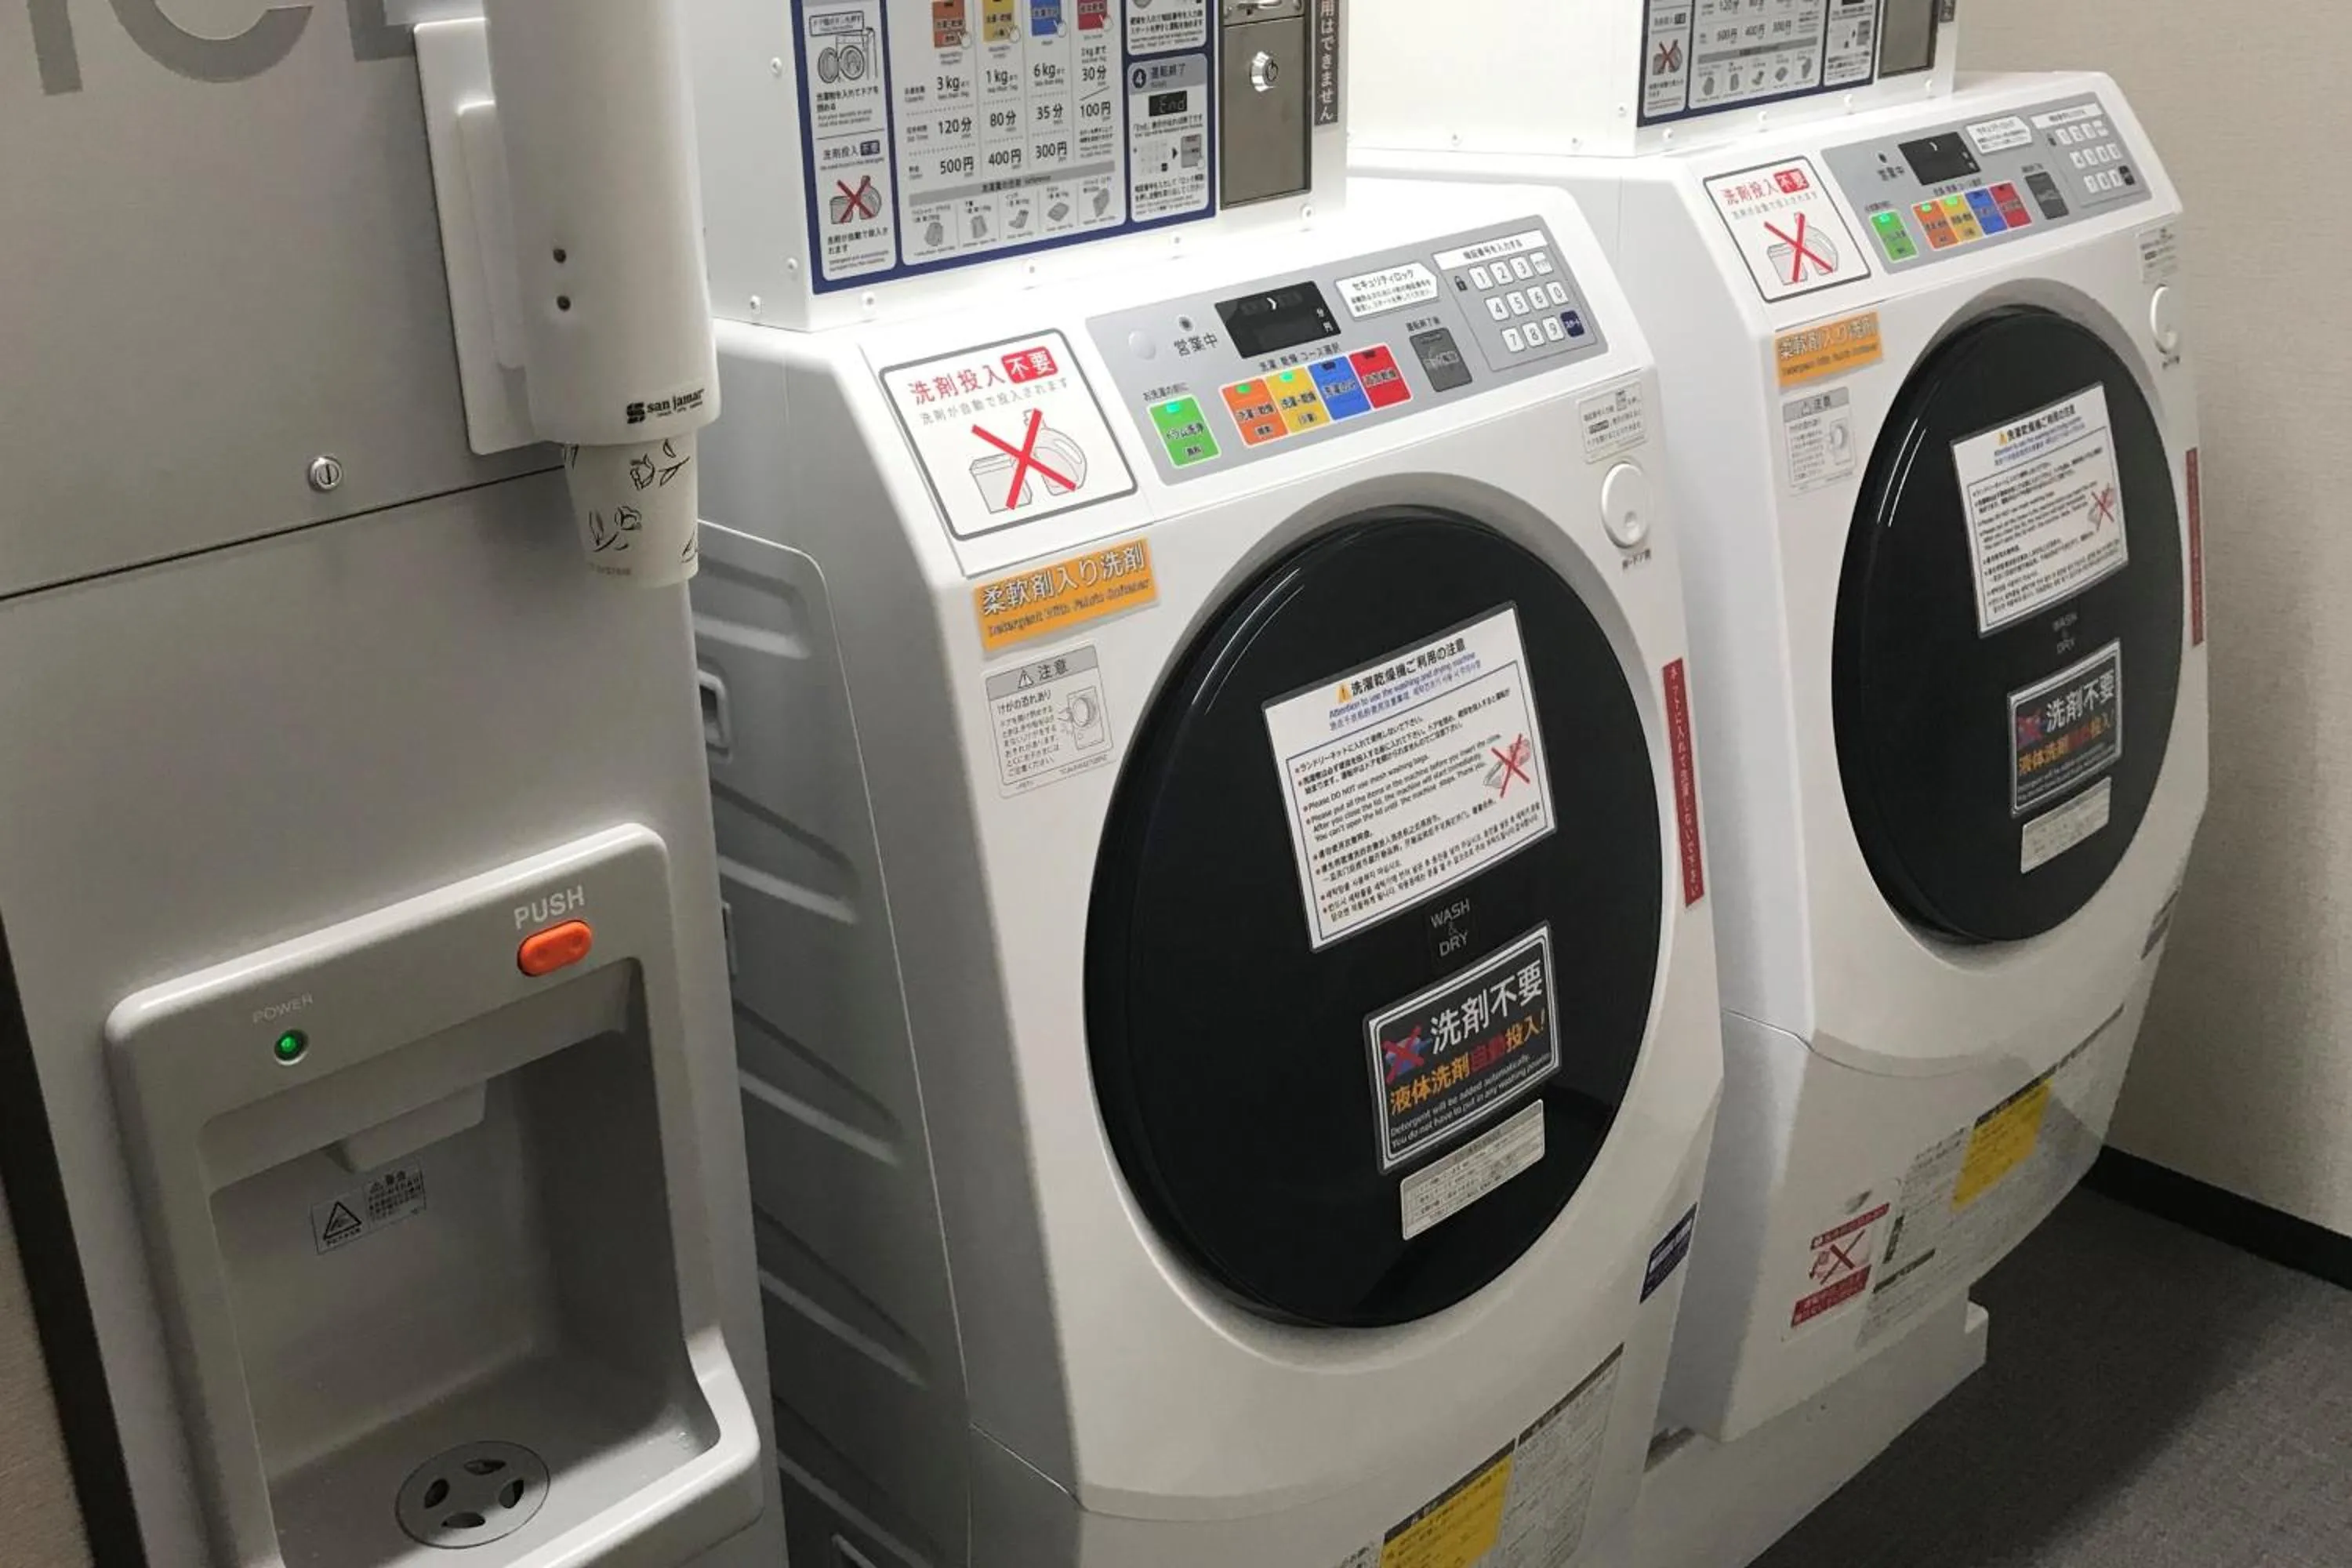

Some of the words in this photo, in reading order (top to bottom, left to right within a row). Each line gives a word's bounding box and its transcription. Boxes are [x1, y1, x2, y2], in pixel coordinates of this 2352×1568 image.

[990, 111, 1016, 127] 80分
[1036, 103, 1063, 120] 35分
[1080, 101, 1111, 118] 100円
[938, 118, 972, 134] 120分
[988, 148, 1022, 166] 400円
[1035, 141, 1067, 158] 300円
[940, 156, 974, 174] 500円
[1173, 332, 1218, 358] 営業中
[909, 350, 1055, 405] 洗剤投入不要
[647, 398, 670, 414] san
[673, 388, 705, 412] jamar
[920, 377, 1068, 426] 洗剤が自動で投入されます
[983, 542, 1145, 615] 柔軟剤入り洗剤
[2046, 669, 2114, 732] 洗剤不要
[1330, 790, 1341, 801] DO
[1341, 783, 1356, 797] NOT
[514, 884, 586, 930] PUSH
[1429, 898, 1471, 928] WASH
[1438, 931, 1470, 957] DRY
[252, 993, 314, 1024] POWER
[1431, 959, 1543, 1054] 洗剤不要
